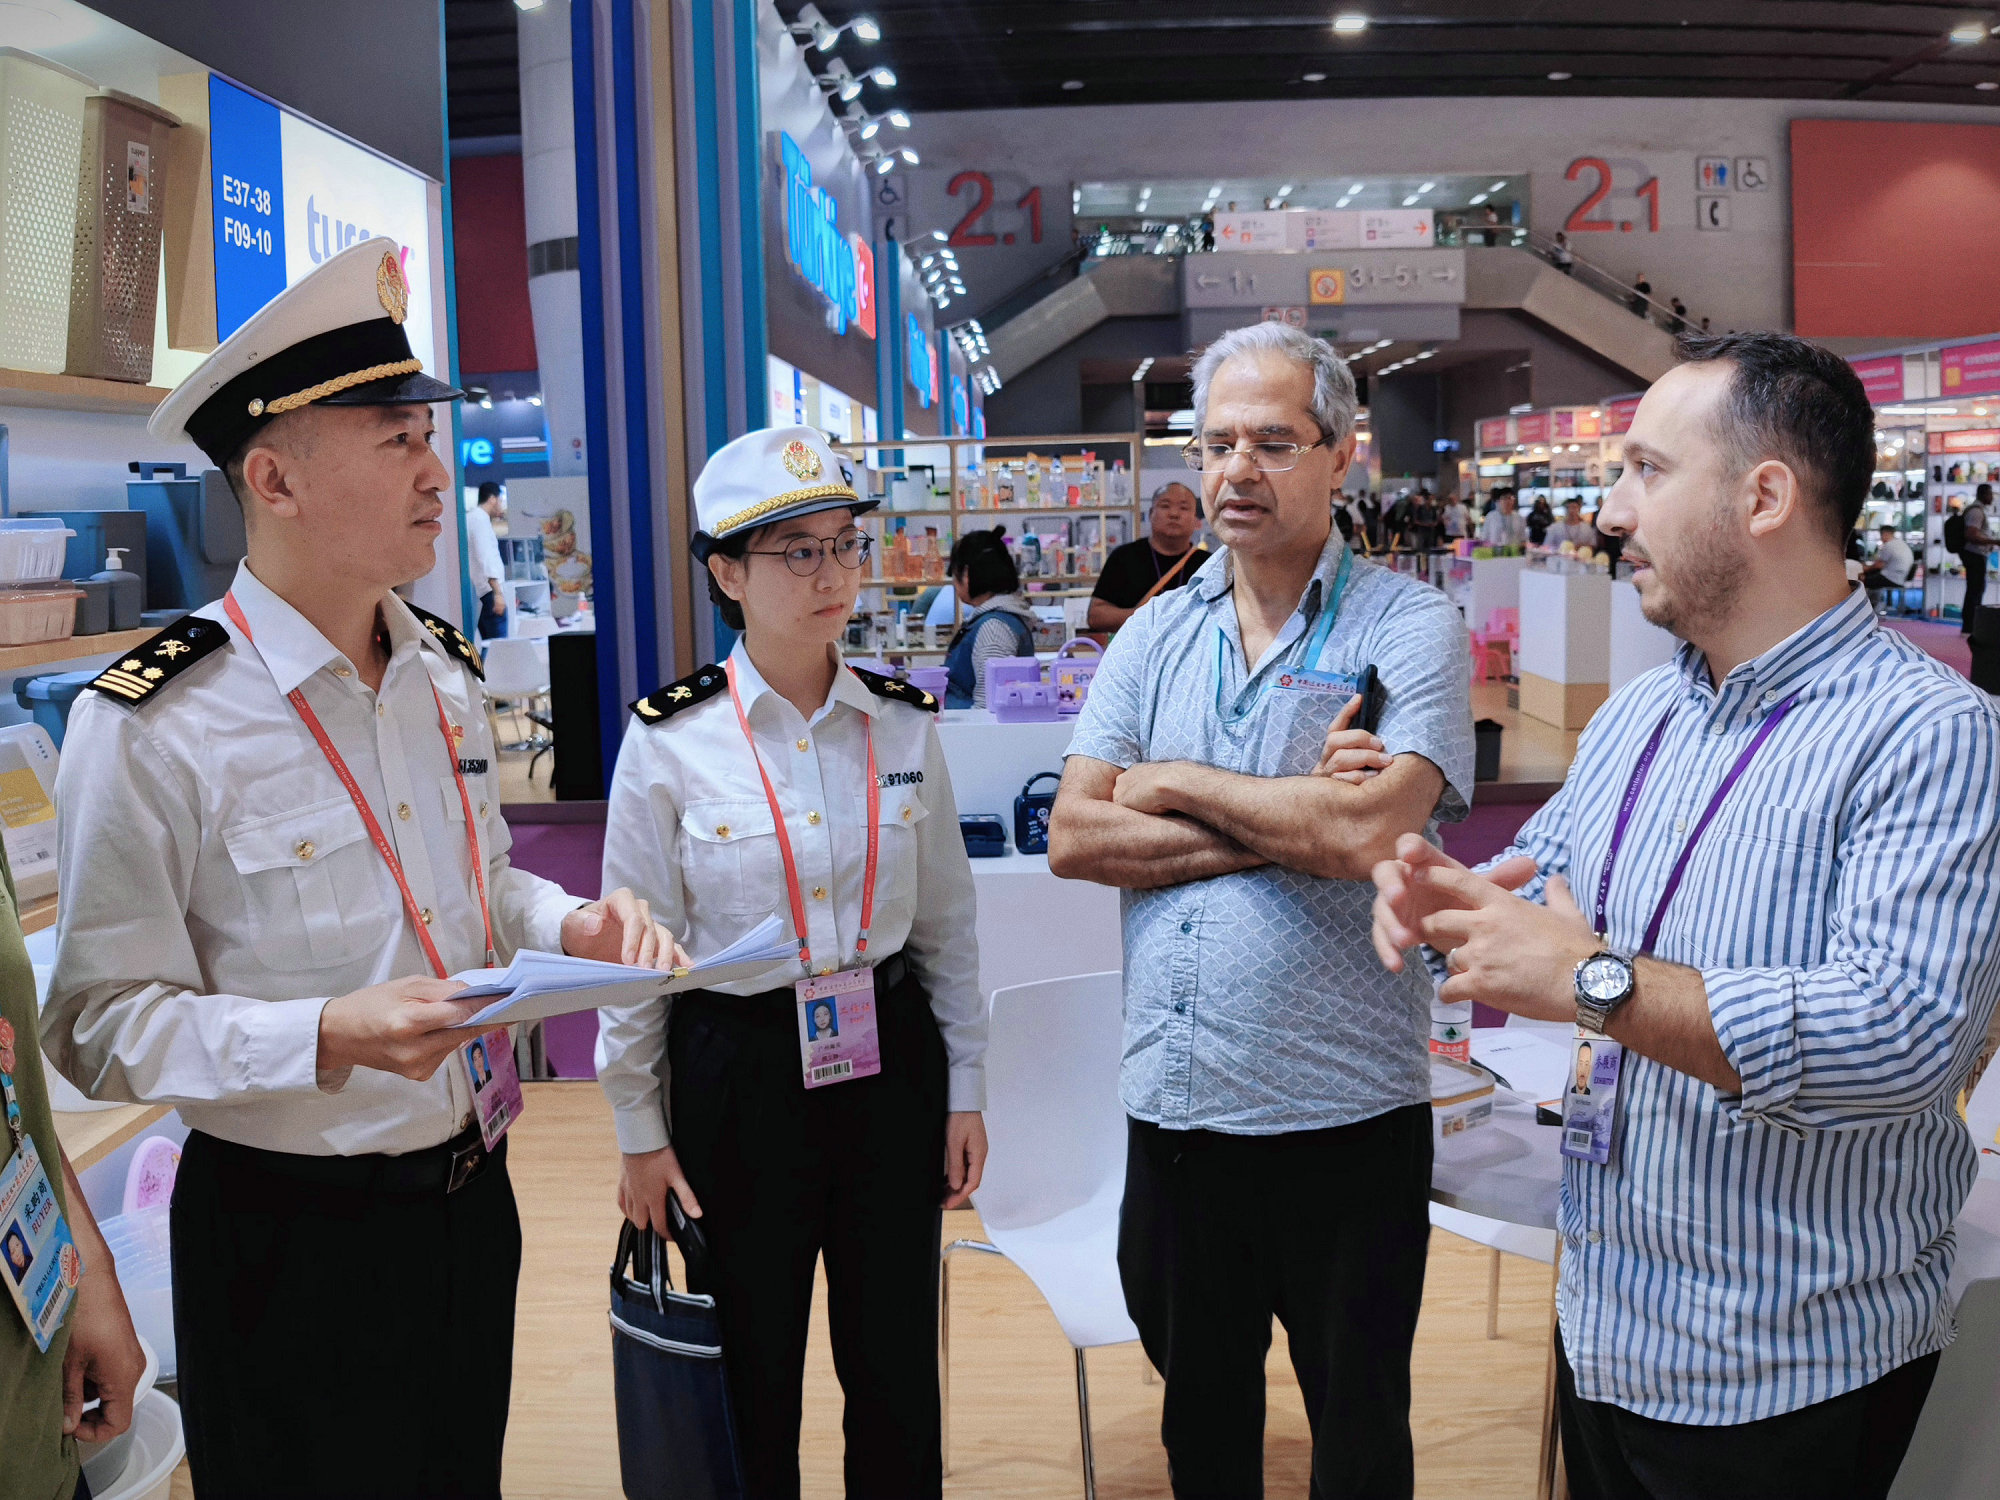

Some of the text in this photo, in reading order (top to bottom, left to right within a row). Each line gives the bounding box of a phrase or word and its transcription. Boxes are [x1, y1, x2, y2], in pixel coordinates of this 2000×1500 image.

[223, 174, 272, 216] E37-38
[946, 170, 1043, 246] 2.1
[1563, 157, 1659, 232] 2.1
[224, 216, 273, 256] F09-10
[24, 1177, 48, 1223] 采购商
[31, 1197, 53, 1236] BUYER
